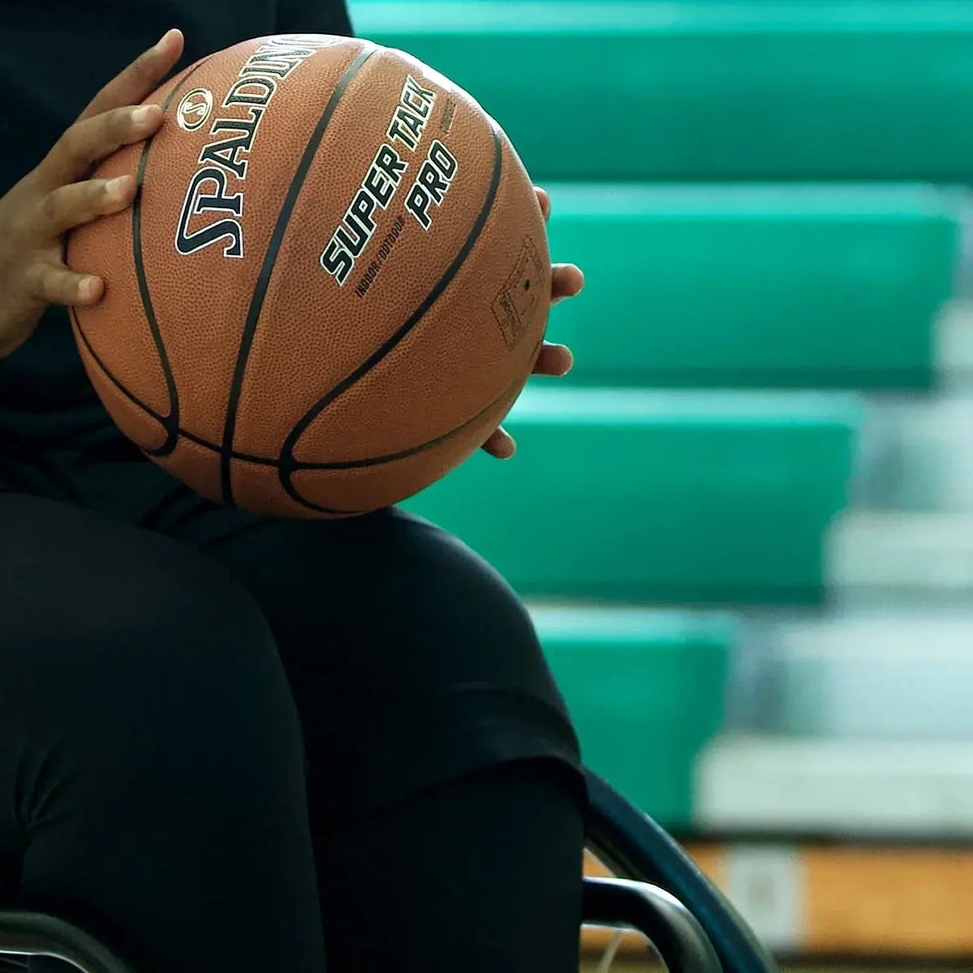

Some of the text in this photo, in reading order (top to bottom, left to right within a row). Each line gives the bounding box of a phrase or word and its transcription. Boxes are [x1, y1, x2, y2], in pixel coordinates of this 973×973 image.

[320, 74, 436, 286] SUPER TACK
[403, 139, 459, 231] PRO
